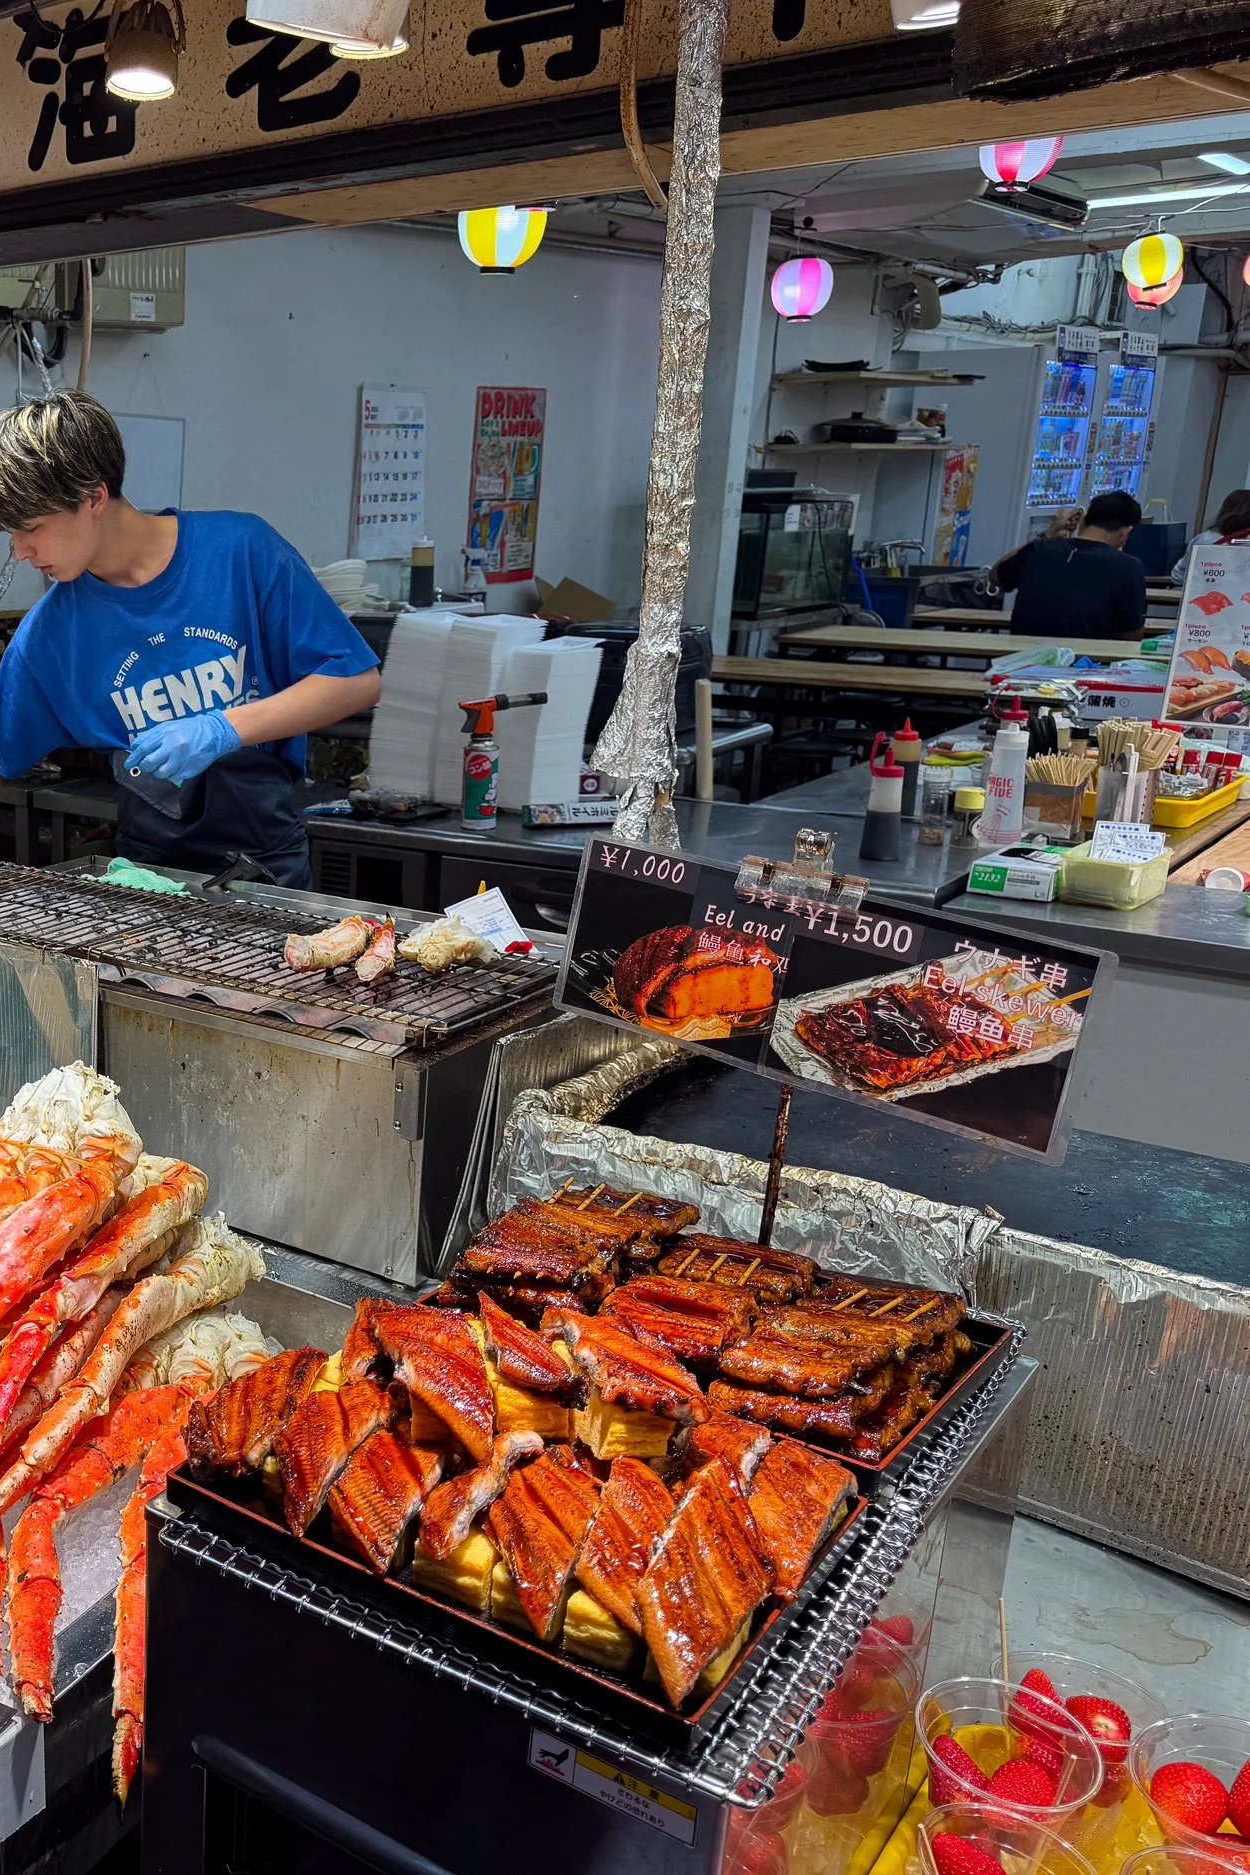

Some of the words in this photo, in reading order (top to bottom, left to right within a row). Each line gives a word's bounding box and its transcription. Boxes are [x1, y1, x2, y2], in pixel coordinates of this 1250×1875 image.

[480, 391, 536, 419] DRINK
[501, 420, 543, 437] LINEUP
[1203, 569, 1225, 577] ¥600
[1189, 629, 1211, 638] ¥800
[113, 651, 140, 688] SETTING
[148, 632, 166, 647] THE
[183, 626, 238, 650] STANDARDS
[109, 644, 247, 731] HENRY
[990, 786, 1013, 798] FIVE
[599, 845, 687, 885] ¥1,000
[704, 904, 735, 929] Eel
[742, 920, 786, 942] and
[804, 904, 914, 955] ¥1,500
[954, 940, 1068, 993] ウナギ串
[923, 963, 967, 996] Eel
[975, 983, 1084, 1029] skewer
[616, 1788, 650, 1810] さわるな
